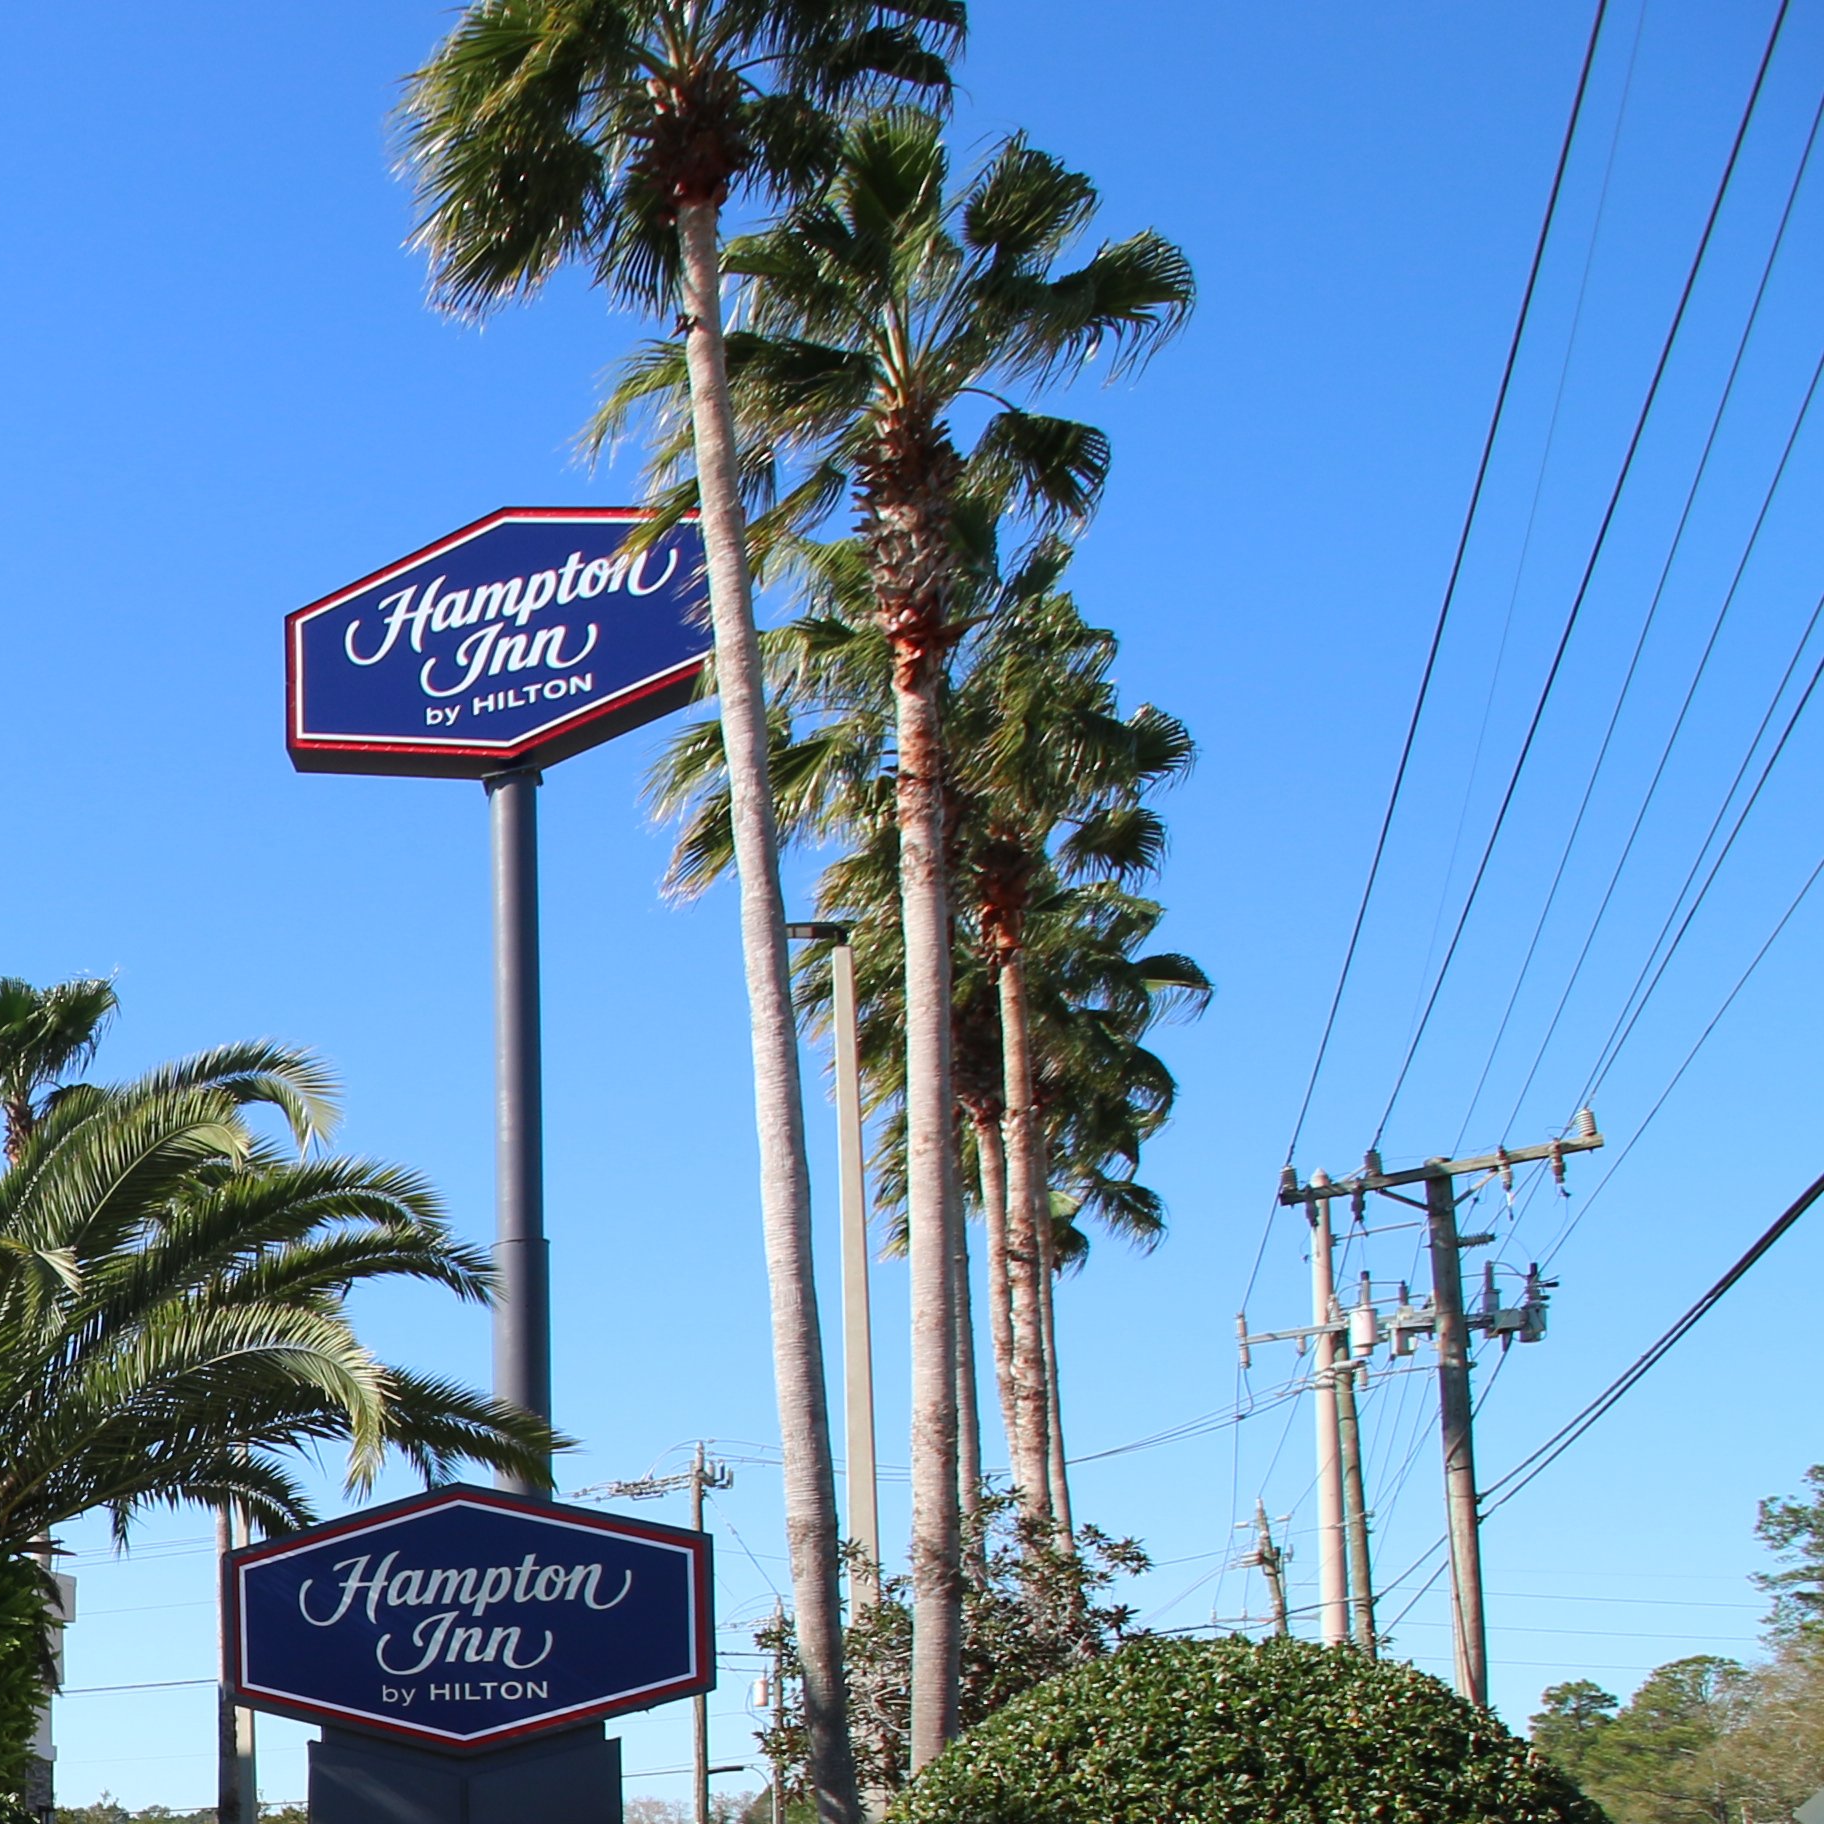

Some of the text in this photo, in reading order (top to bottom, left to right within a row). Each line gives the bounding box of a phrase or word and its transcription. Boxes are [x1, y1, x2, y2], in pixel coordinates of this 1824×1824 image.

[345, 547, 678, 666] Hampton
[420, 621, 599, 698] Inn
[426, 672, 594, 727] by HILTON
[299, 1550, 632, 1627] Hampton
[376, 1611, 553, 1675] Inn
[381, 1680, 549, 1707] by HILTON
